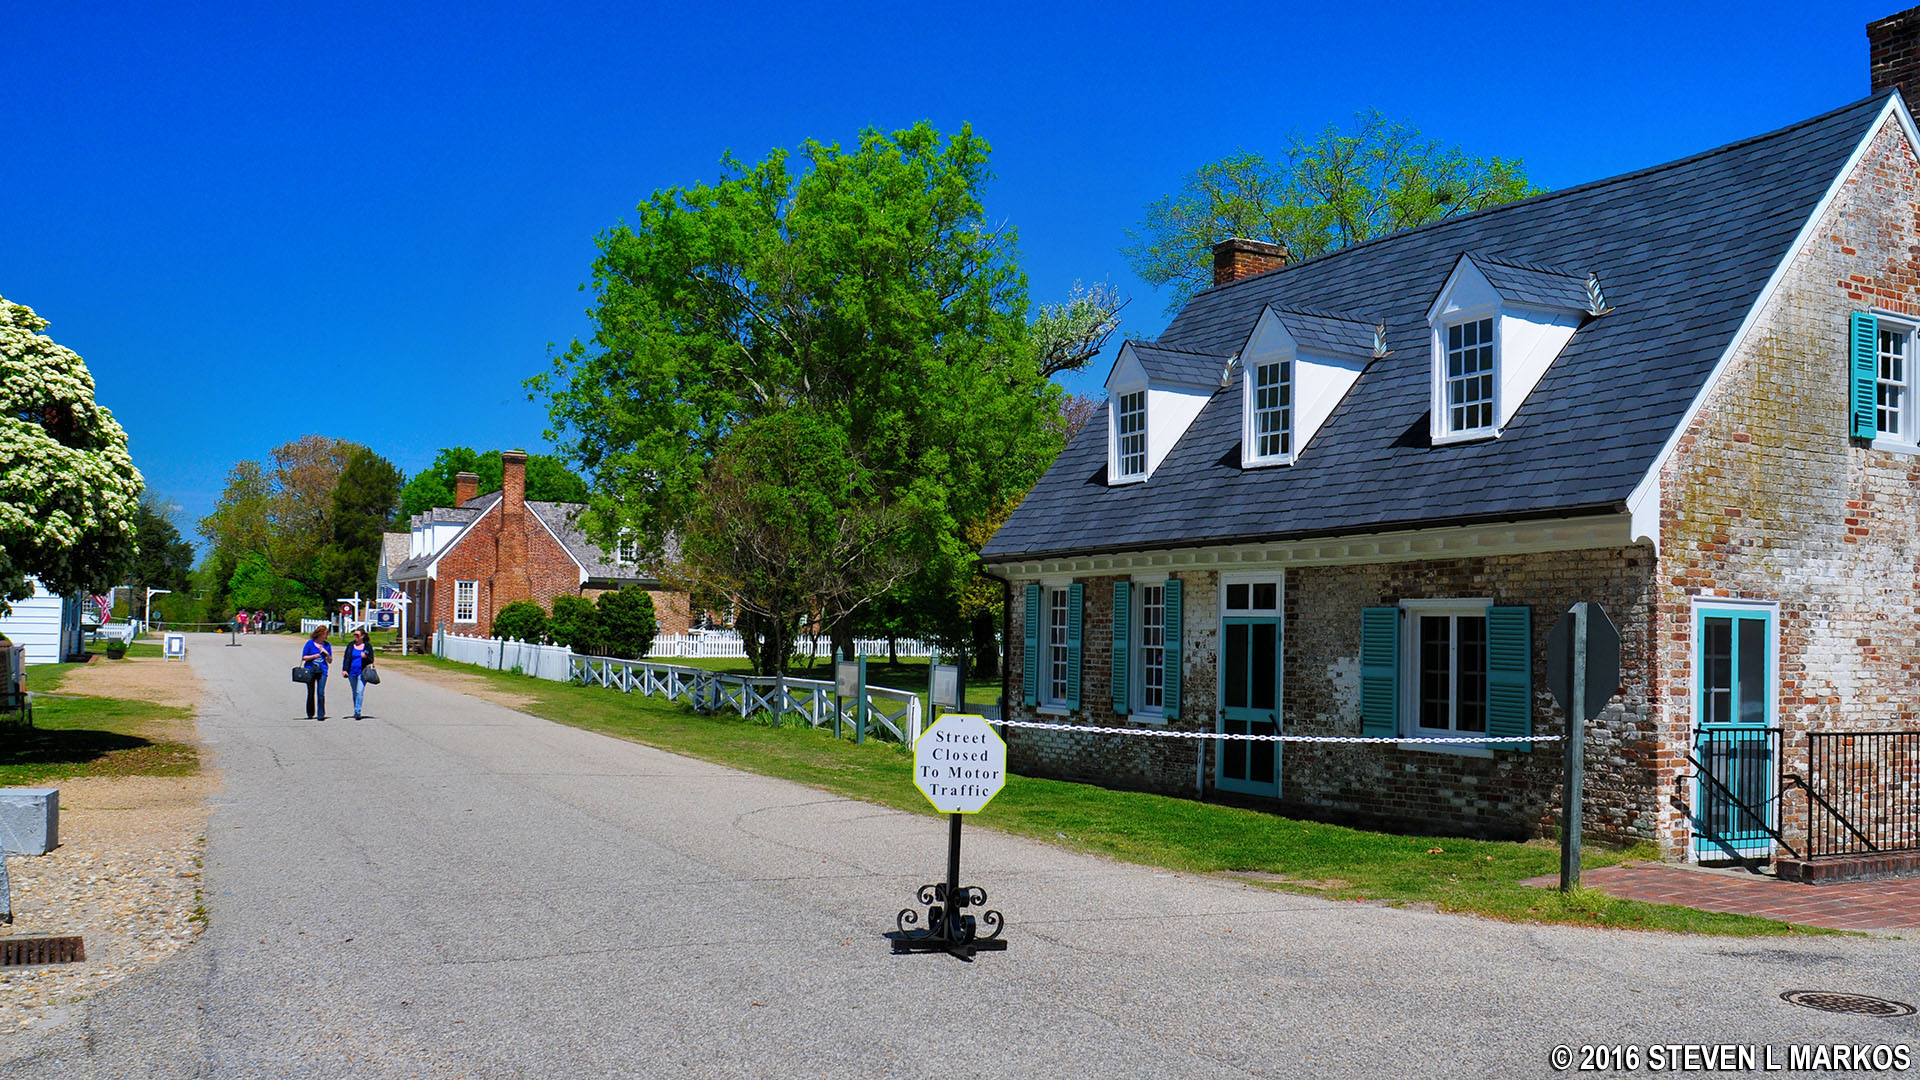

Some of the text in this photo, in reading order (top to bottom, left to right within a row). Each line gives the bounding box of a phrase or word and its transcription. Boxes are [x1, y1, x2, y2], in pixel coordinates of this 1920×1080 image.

[936, 730, 986, 744] Street
[932, 748, 988, 762] Closed
[920, 765, 999, 780] To Motor
[930, 783, 989, 797] Traffic
